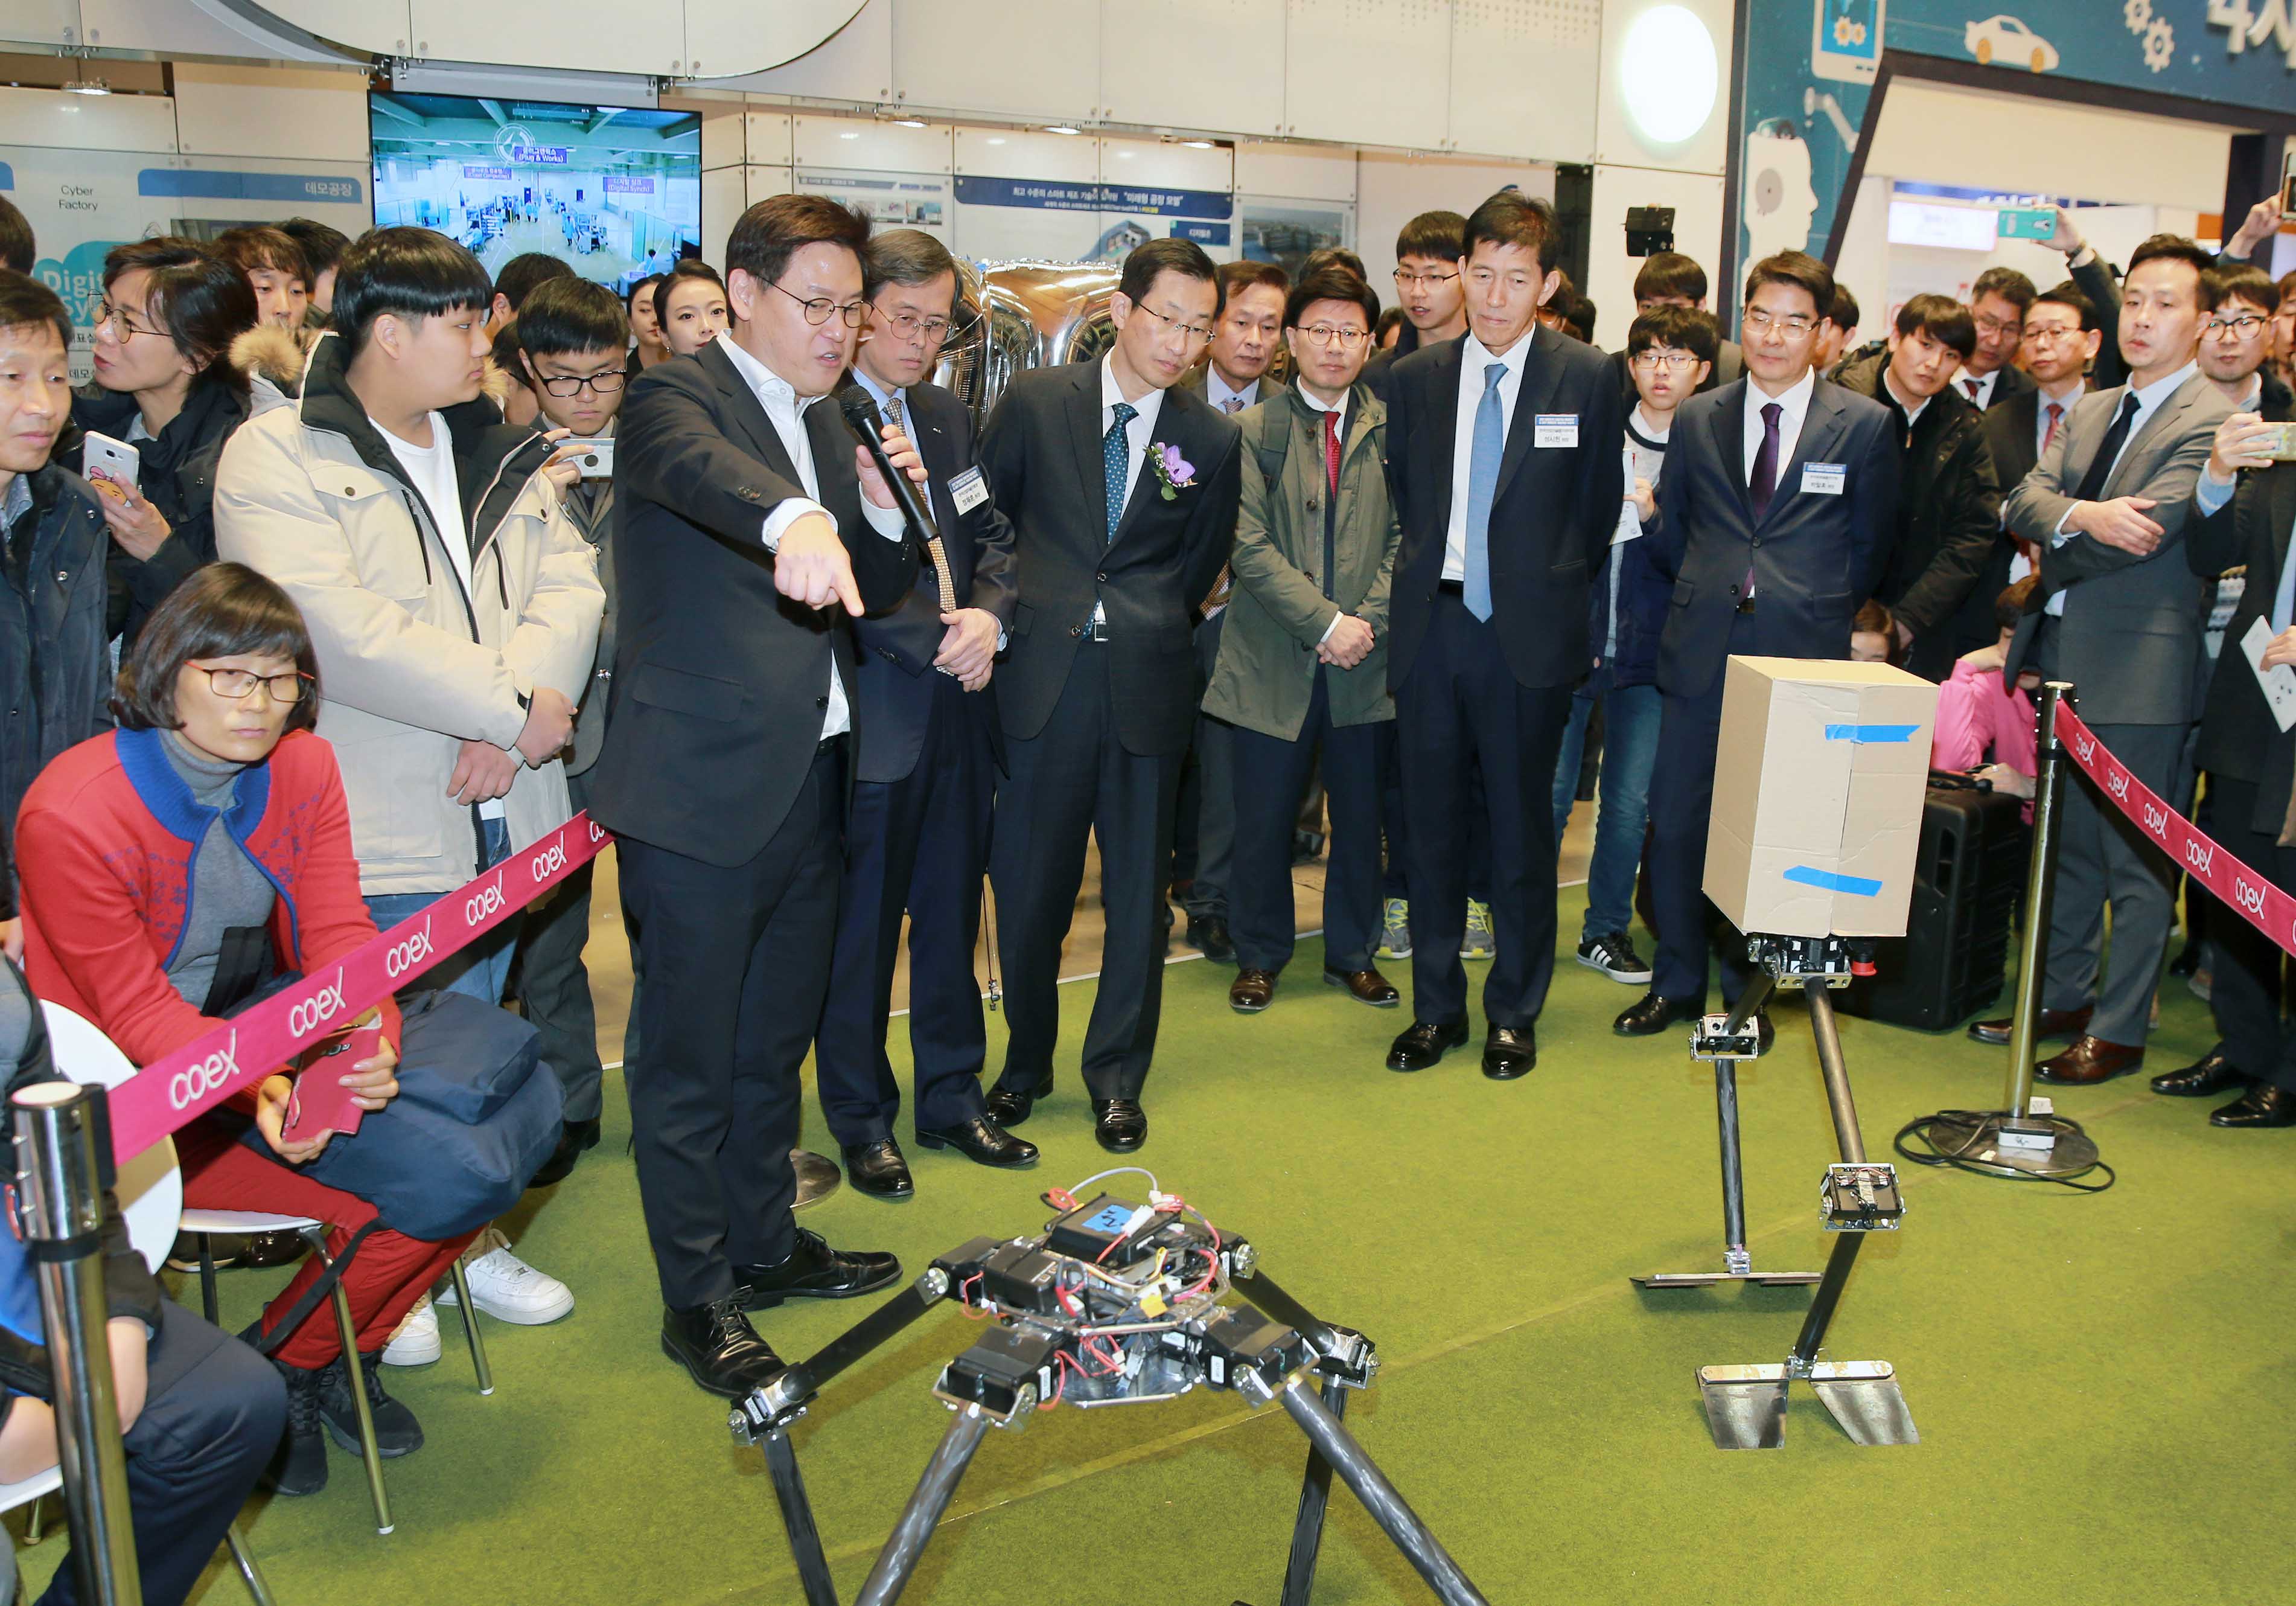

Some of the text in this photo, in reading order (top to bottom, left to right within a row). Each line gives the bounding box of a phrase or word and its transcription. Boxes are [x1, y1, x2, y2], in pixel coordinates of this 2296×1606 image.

[542, 154, 564, 163] Works)
[59, 199, 98, 211] Factory
[61, 185, 94, 196] Cyber
[305, 182, 352, 197] 데모공장
[2144, 802, 2169, 840] coex
[533, 830, 567, 882] coex
[2186, 838, 2213, 878] coex
[466, 869, 506, 926] coex
[2236, 877, 2266, 920] coex
[387, 914, 434, 977] coex
[290, 966, 346, 1038] coex
[169, 1028, 240, 1110] coex
